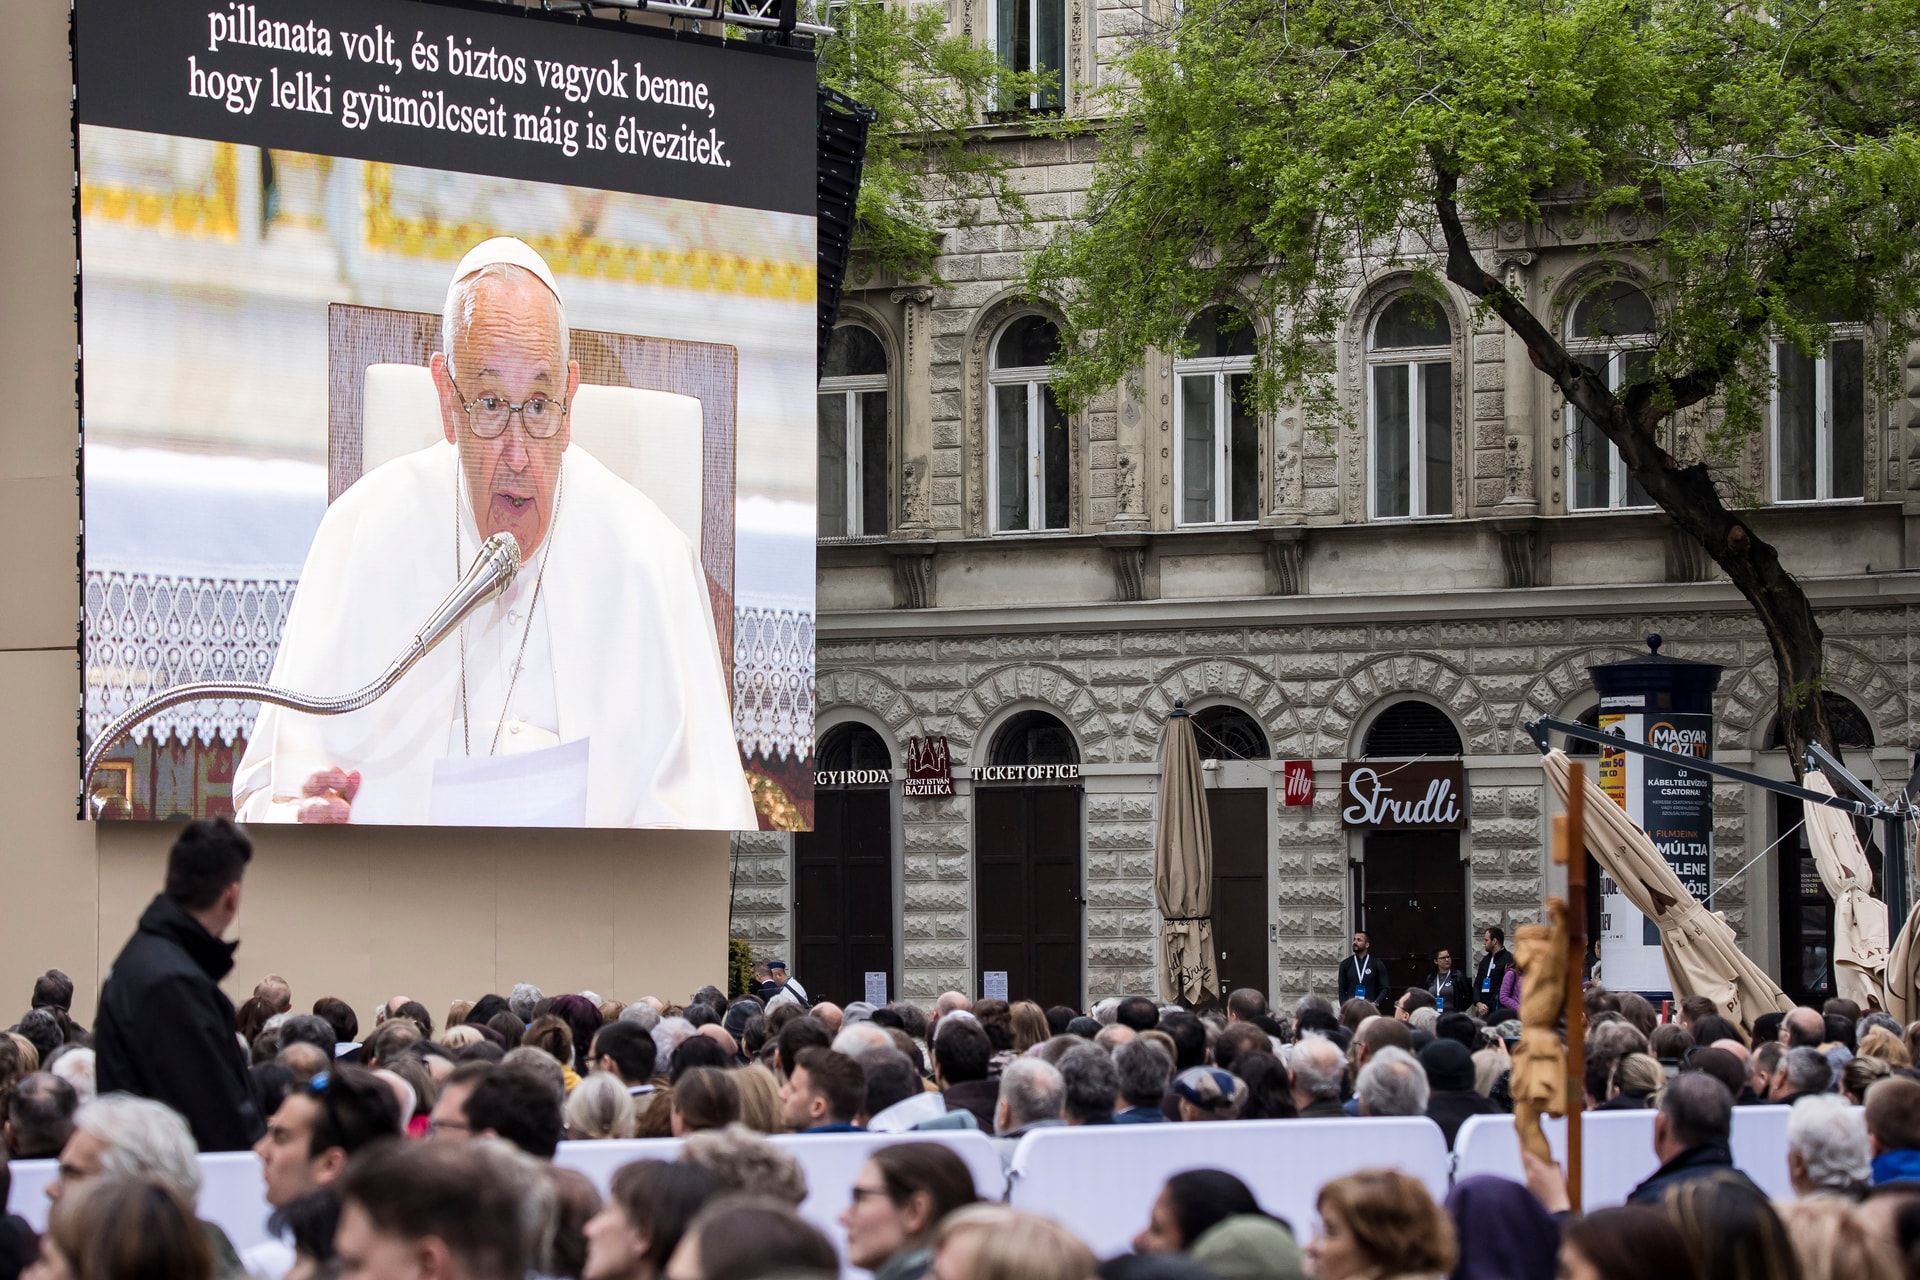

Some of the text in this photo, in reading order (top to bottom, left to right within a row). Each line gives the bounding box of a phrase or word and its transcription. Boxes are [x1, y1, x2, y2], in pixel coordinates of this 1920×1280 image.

[207, 2, 715, 118] pillanata volt, és biztos vagyok benne,
[188, 55, 731, 168] hogy lelki gyümölcseit máig is élvezitek.
[1653, 729, 1707, 744] MAGYAR
[1613, 758, 1625, 768] 50
[971, 764, 1079, 781] TICKET OFFICE
[905, 777, 950, 786] SZENT ISTVÁN
[1287, 767, 1312, 802] illy
[905, 784, 952, 796] BAZILIKA
[1343, 767, 1461, 825] Strudli
[1656, 829, 1698, 838] FILMJEINK
[1656, 840, 1708, 856] MÚLTJA
